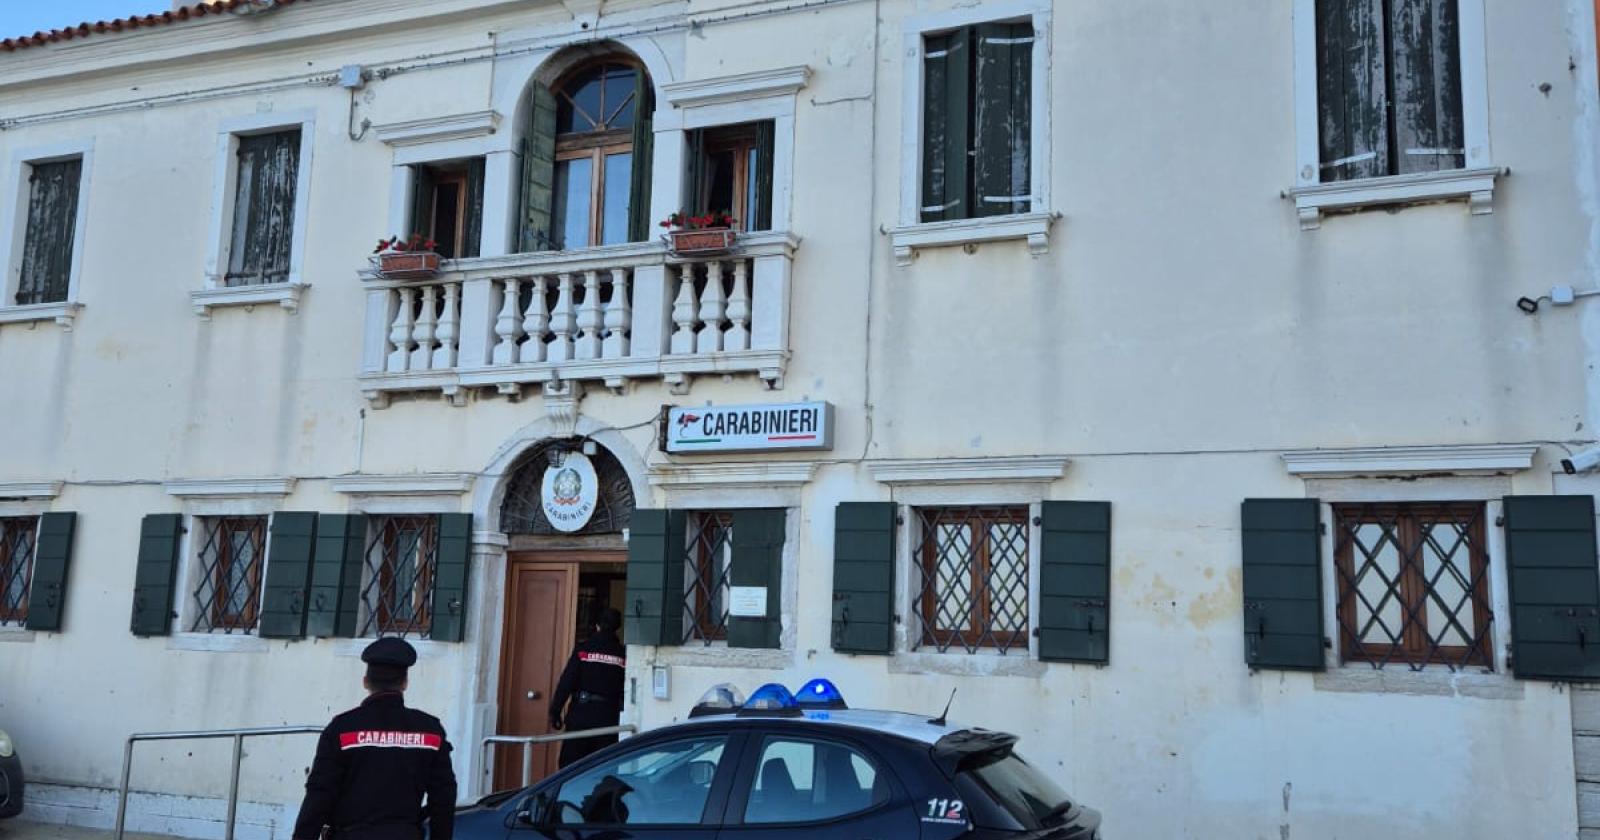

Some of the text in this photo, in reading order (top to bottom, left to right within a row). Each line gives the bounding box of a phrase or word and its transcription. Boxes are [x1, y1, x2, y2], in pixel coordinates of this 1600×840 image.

[703, 408, 818, 436] CARABINIERI
[545, 501, 592, 521] CARABINIERI
[357, 731, 425, 745] CARABINIERI
[927, 798, 963, 818] 112
